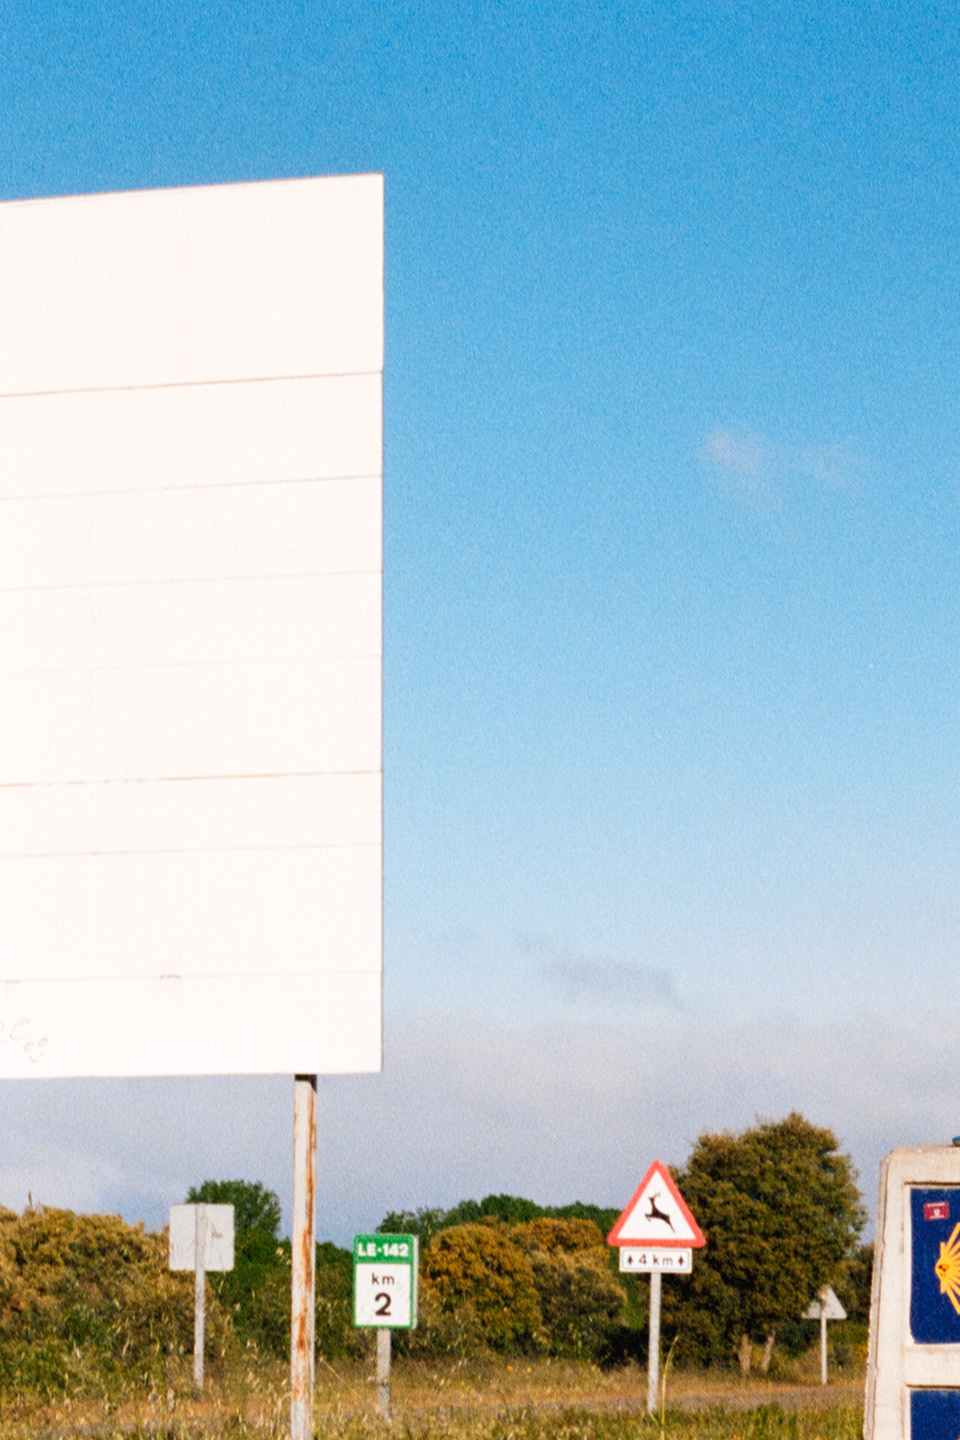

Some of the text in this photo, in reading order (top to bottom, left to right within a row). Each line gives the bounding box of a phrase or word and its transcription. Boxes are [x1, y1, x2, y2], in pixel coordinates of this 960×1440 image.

[639, 1254, 673, 1266] 4 km
[372, 1272, 395, 1286] km
[374, 1292, 392, 1317] 2
